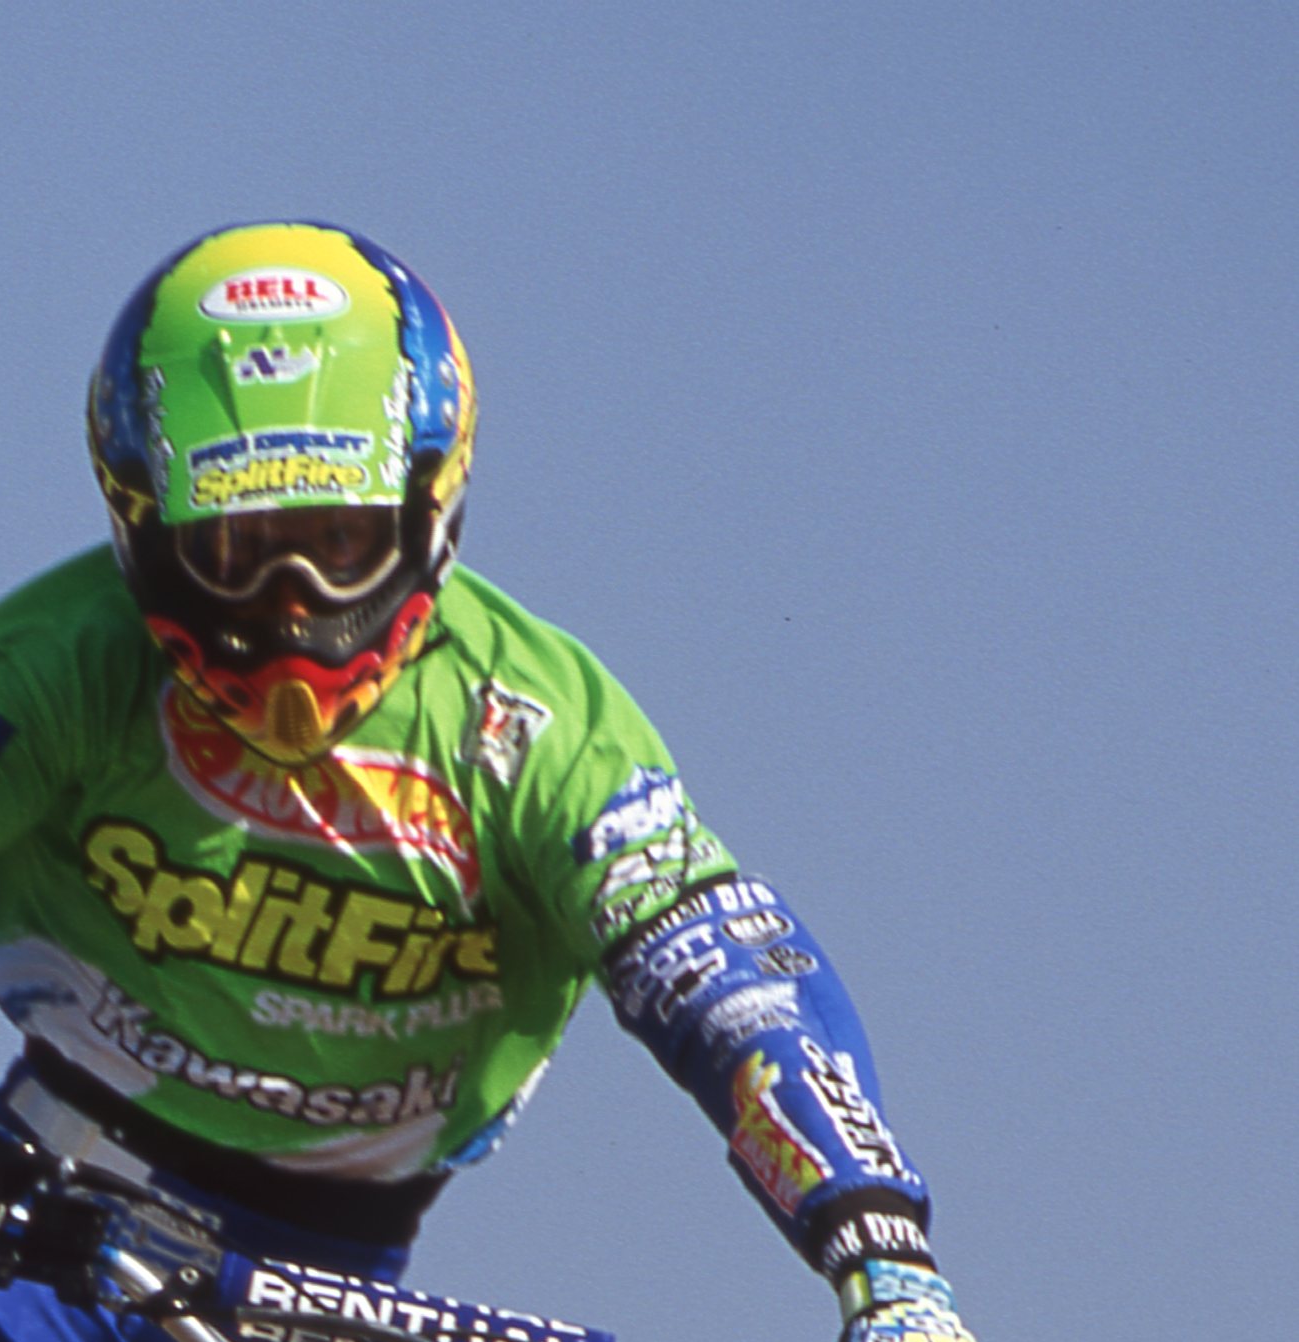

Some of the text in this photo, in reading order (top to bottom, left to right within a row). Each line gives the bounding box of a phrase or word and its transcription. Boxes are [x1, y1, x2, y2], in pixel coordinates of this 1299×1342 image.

[225, 277, 330, 301] BELL
[193, 455, 367, 507] SplitFire
[83, 823, 498, 994] SplitFire
[251, 988, 395, 1041] SPARK
[90, 986, 459, 1124] Kawasaki
